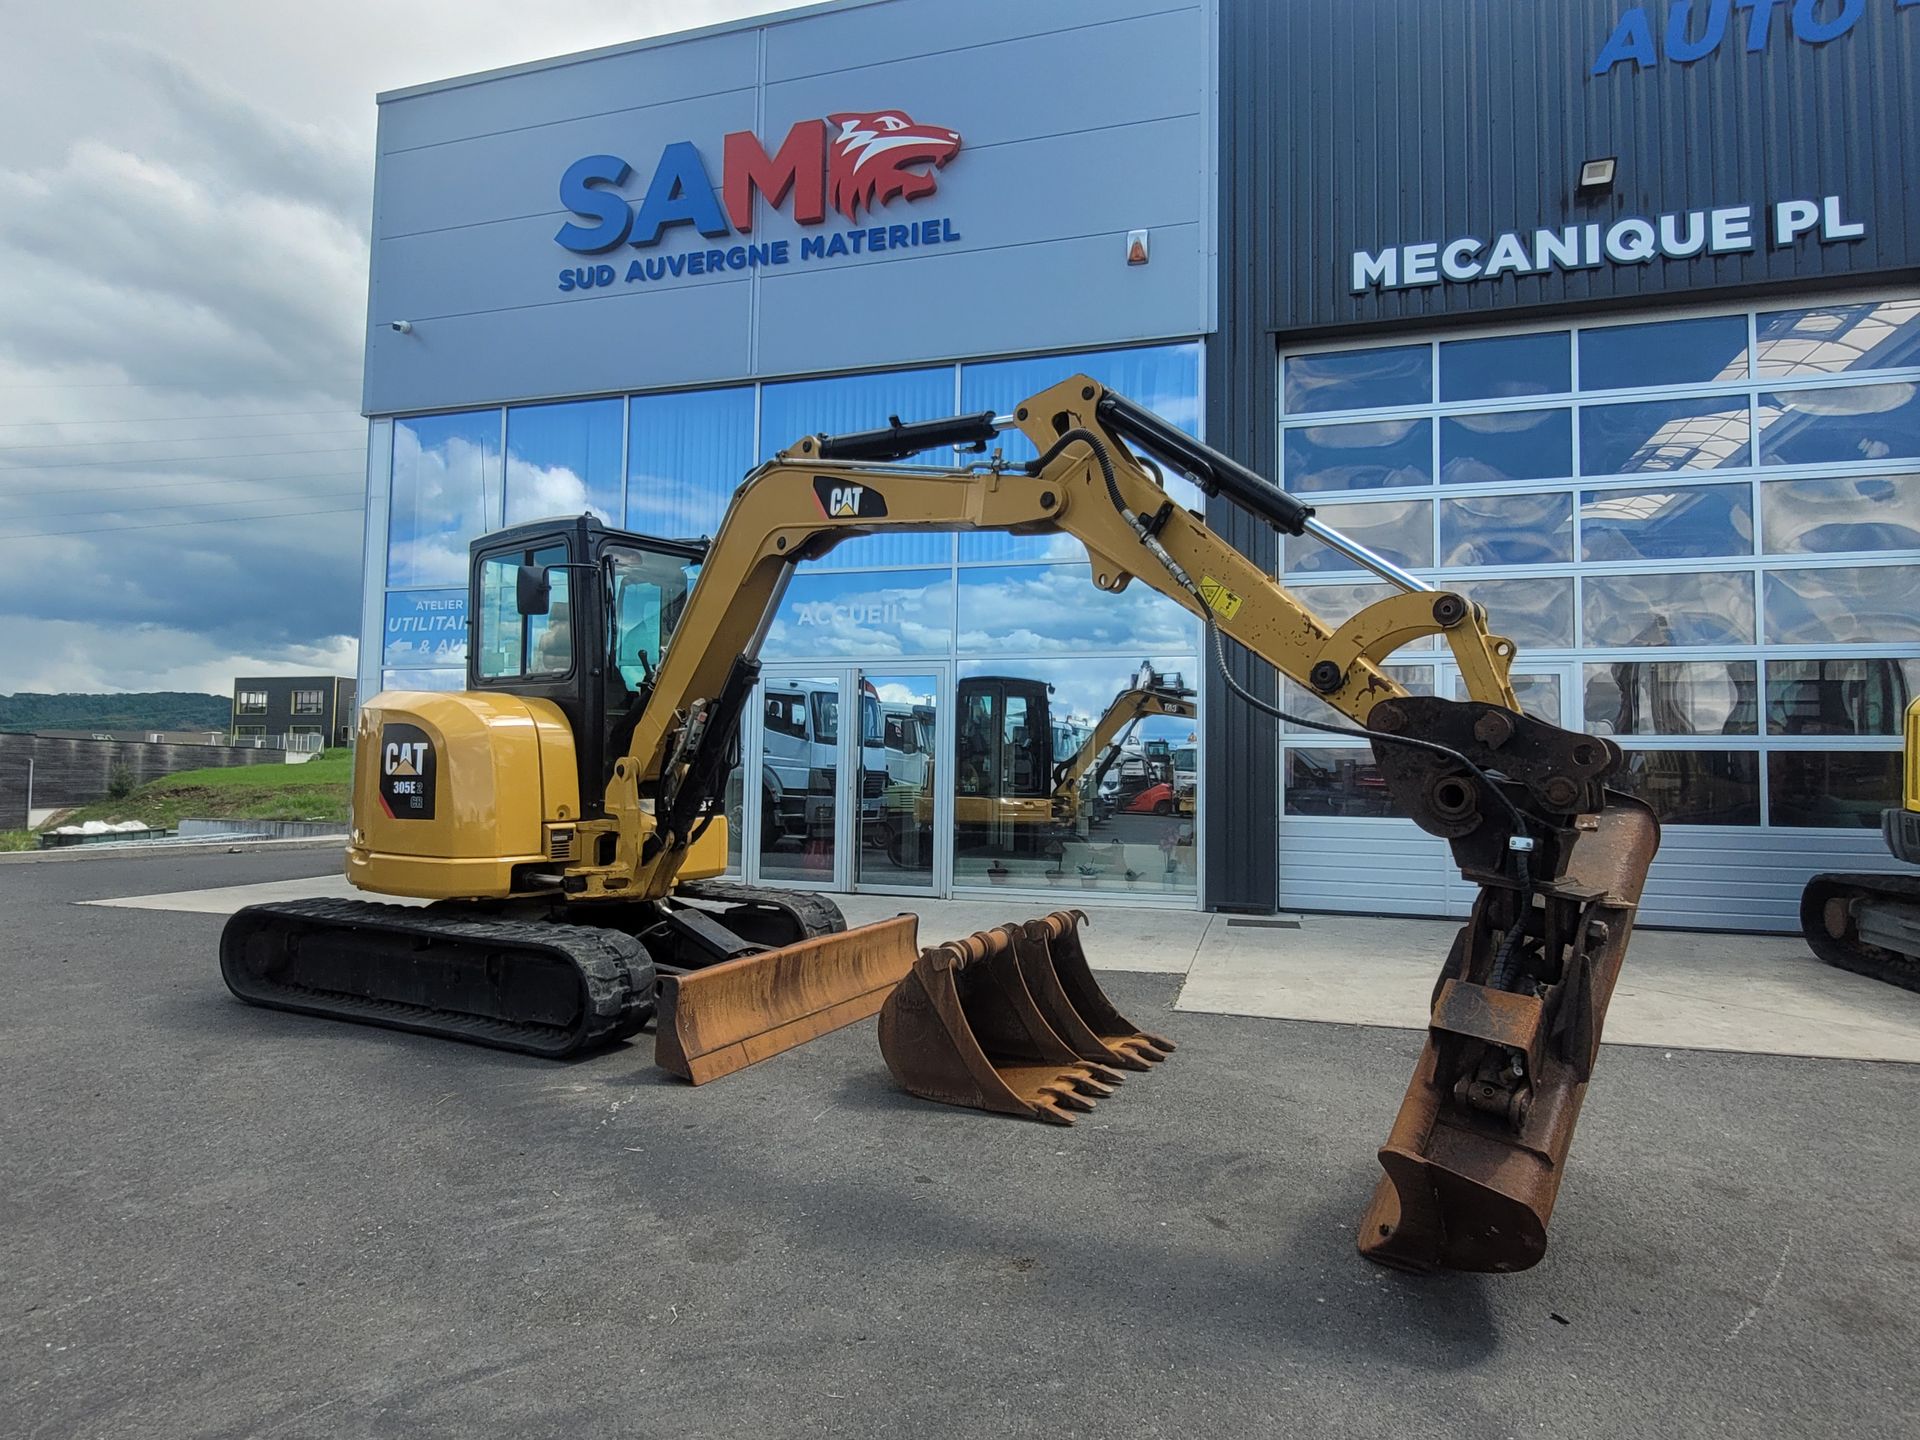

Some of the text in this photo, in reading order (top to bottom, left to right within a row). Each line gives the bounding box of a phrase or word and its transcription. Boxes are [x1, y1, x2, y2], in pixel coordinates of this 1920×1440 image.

[1591, 0, 1866, 75] AUTO
[554, 118, 828, 256] SAM
[558, 218, 961, 292] SUD AUVERGNE MATERIEL
[1352, 195, 1866, 293] MECANIQUE PL
[829, 487, 863, 516] CAT
[416, 599, 463, 611] ATELIER
[797, 604, 904, 626] ACCUEIL
[419, 638, 468, 656] & AU
[385, 742, 428, 775] CAT
